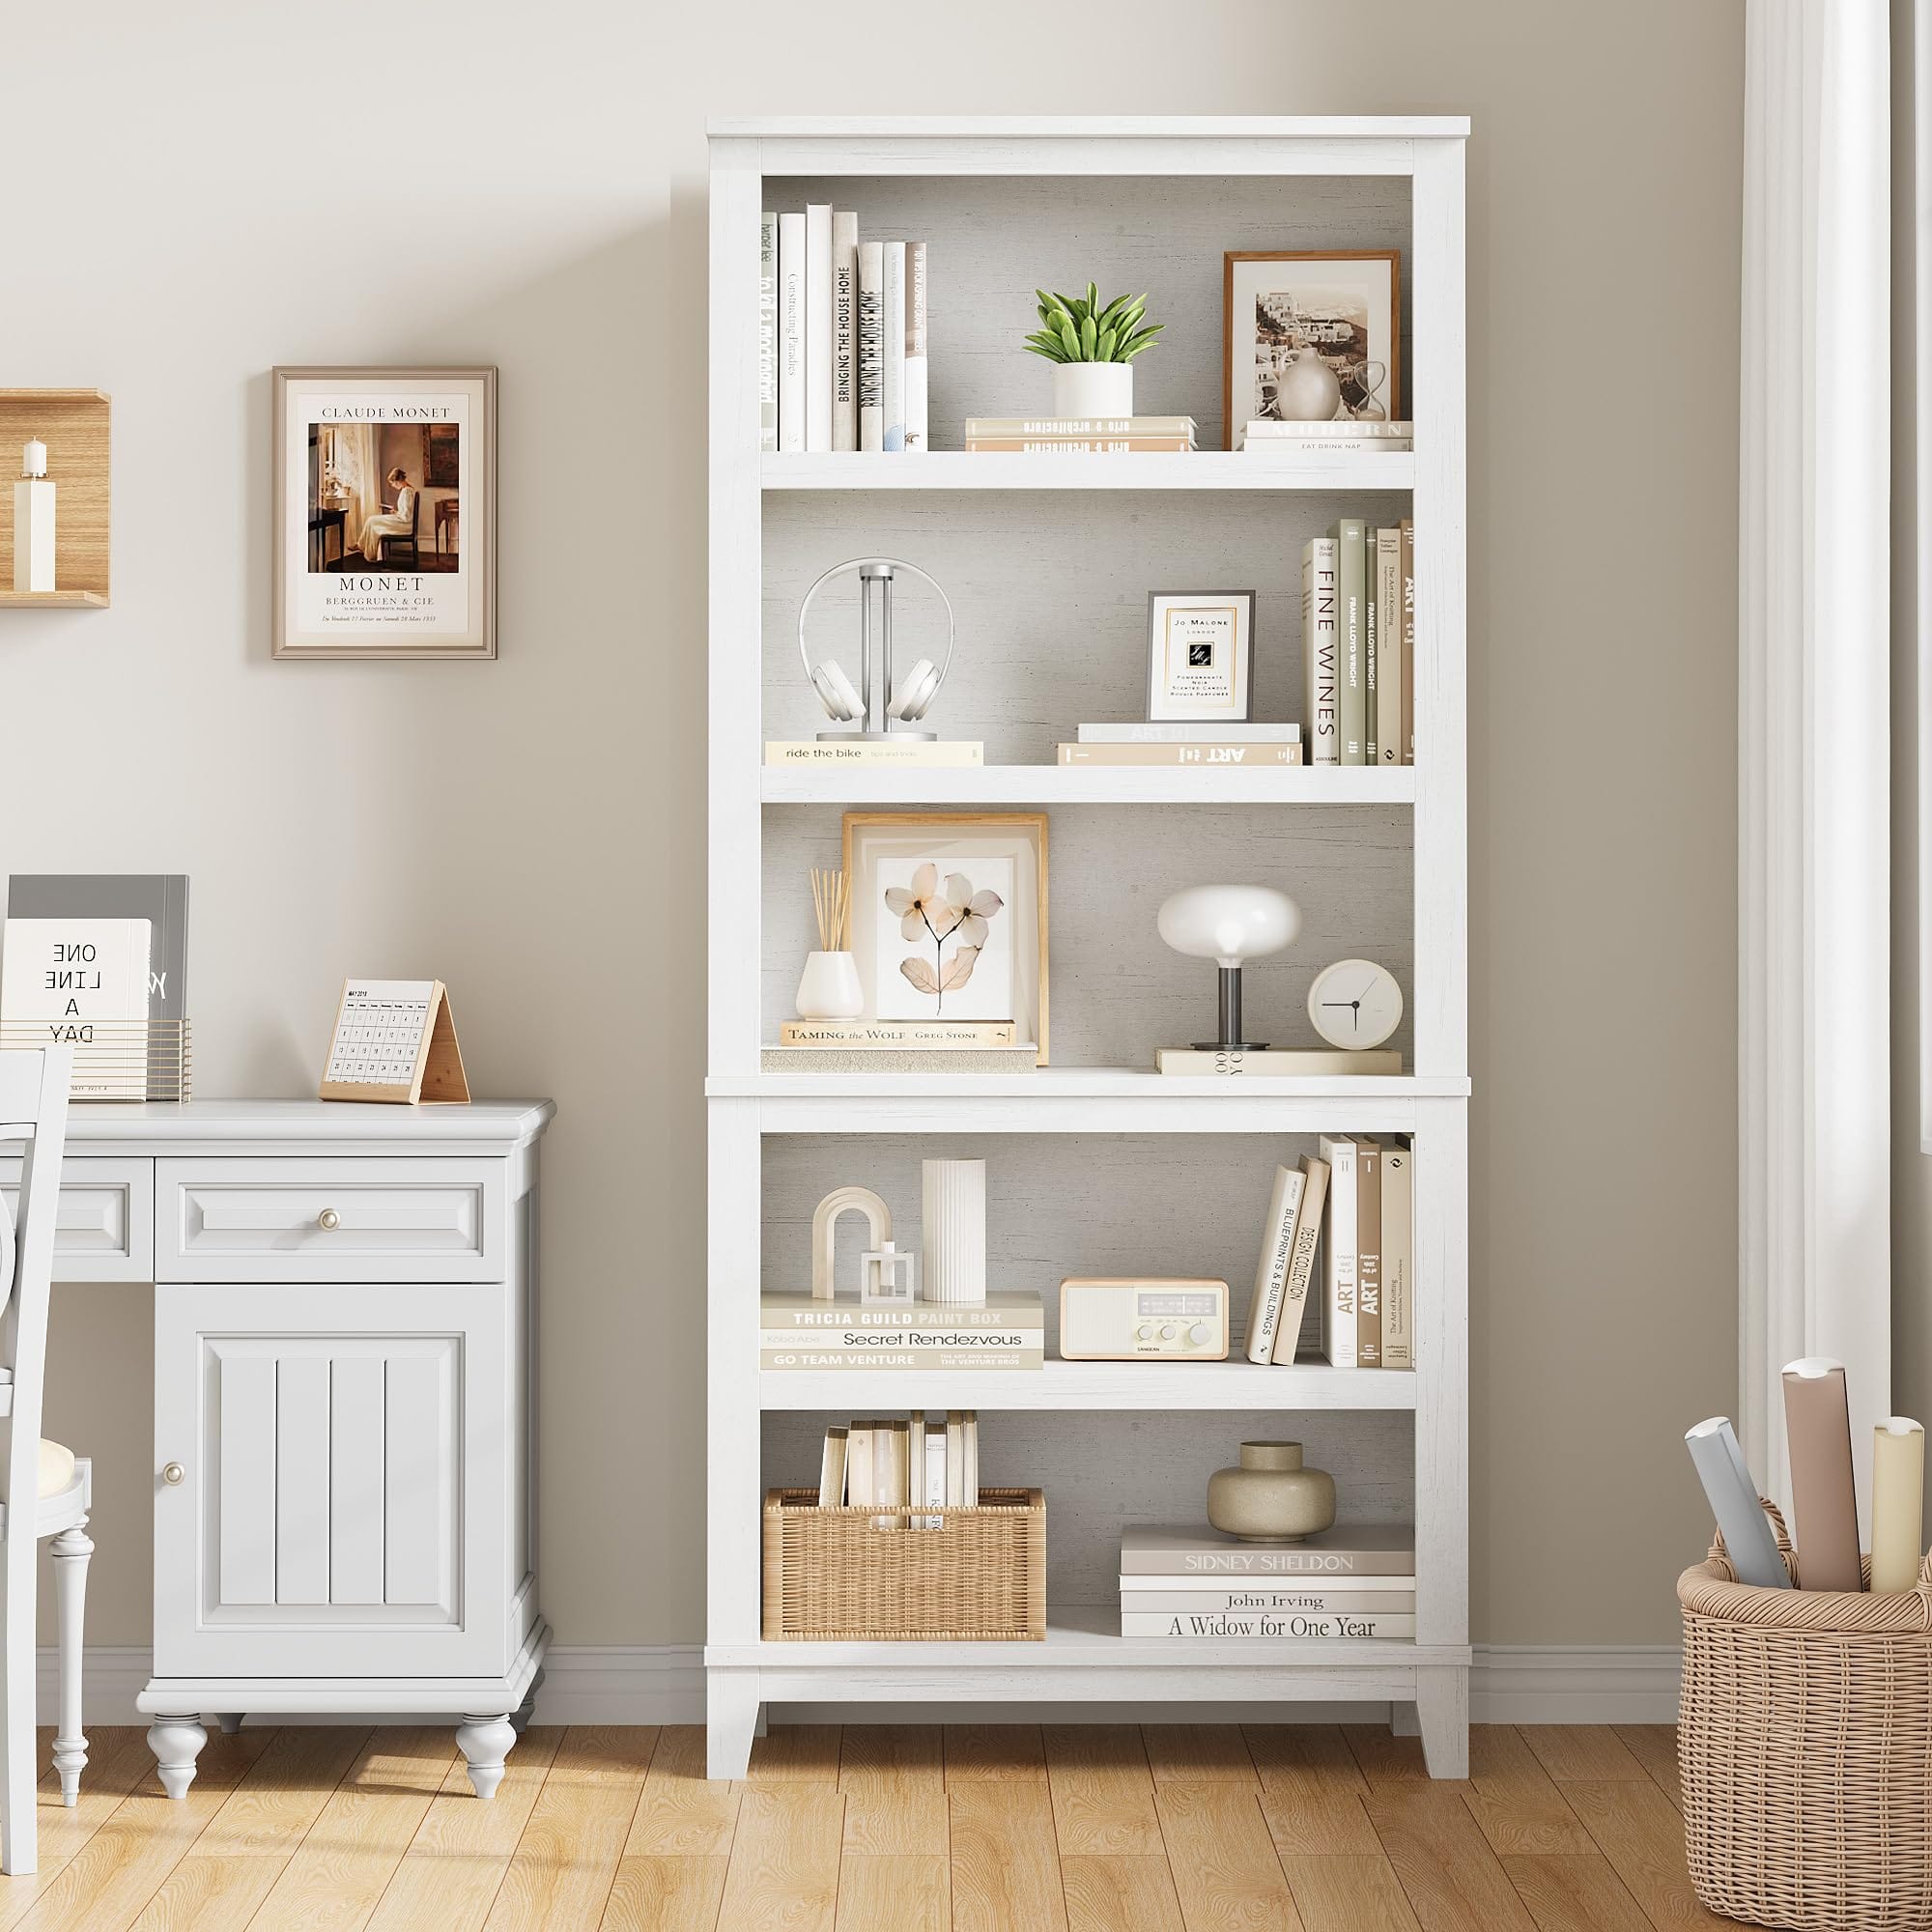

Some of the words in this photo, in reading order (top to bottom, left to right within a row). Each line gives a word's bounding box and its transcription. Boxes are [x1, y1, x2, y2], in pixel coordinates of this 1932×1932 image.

[838, 267, 849, 294] HOME
[785, 273, 797, 333] Constructing
[838, 298, 849, 328] HOUSE
[838, 332, 849, 352] THE
[838, 355, 849, 402] BRINGING
[322, 408, 385, 418] CLAUDE
[392, 408, 451, 418] MONET
[339, 577, 425, 591] MONET
[1318, 570, 1334, 630] FINE
[1318, 645, 1334, 736] WINES
[785, 748, 810, 758] ride
[813, 748, 833, 758] the
[837, 748, 862, 758] bike
[1207, 748, 1246, 762] ART
[788, 1030, 844, 1039] TAMING
[848, 1030, 864, 1039] the
[866, 1030, 906, 1039] WOLF
[915, 1031, 943, 1039] GREG
[946, 1030, 979, 1039] STONE
[1275, 1208, 1294, 1271] BLUEPRINTS
[1298, 1227, 1316, 1255] DESIGN
[1290, 1257, 1310, 1301] COLLECTION
[1262, 1282, 1281, 1336] BUILDINGS
[1338, 1280, 1352, 1314] ART
[1360, 1279, 1378, 1316] ART
[792, 1313, 853, 1325] TRICIA
[860, 1313, 913, 1325] GUILD
[918, 1314, 964, 1325] PAINT
[972, 1314, 1003, 1325] BOX
[843, 1333, 904, 1346] Secret
[909, 1333, 1022, 1346] Rendezvous
[774, 1354, 799, 1365] GO
[802, 1354, 842, 1365] TEAM
[846, 1354, 916, 1365] VENTURE
[1184, 1555, 1254, 1570] SIDNEY
[1260, 1555, 1353, 1570] SHELDON
[1225, 1595, 1264, 1609] John
[1271, 1596, 1324, 1609] Irving
[1167, 1616, 1183, 1635] A
[1190, 1616, 1255, 1636] Widow
[1260, 1615, 1286, 1635] for
[1291, 1617, 1330, 1636] One
[1335, 1617, 1377, 1636] Year
